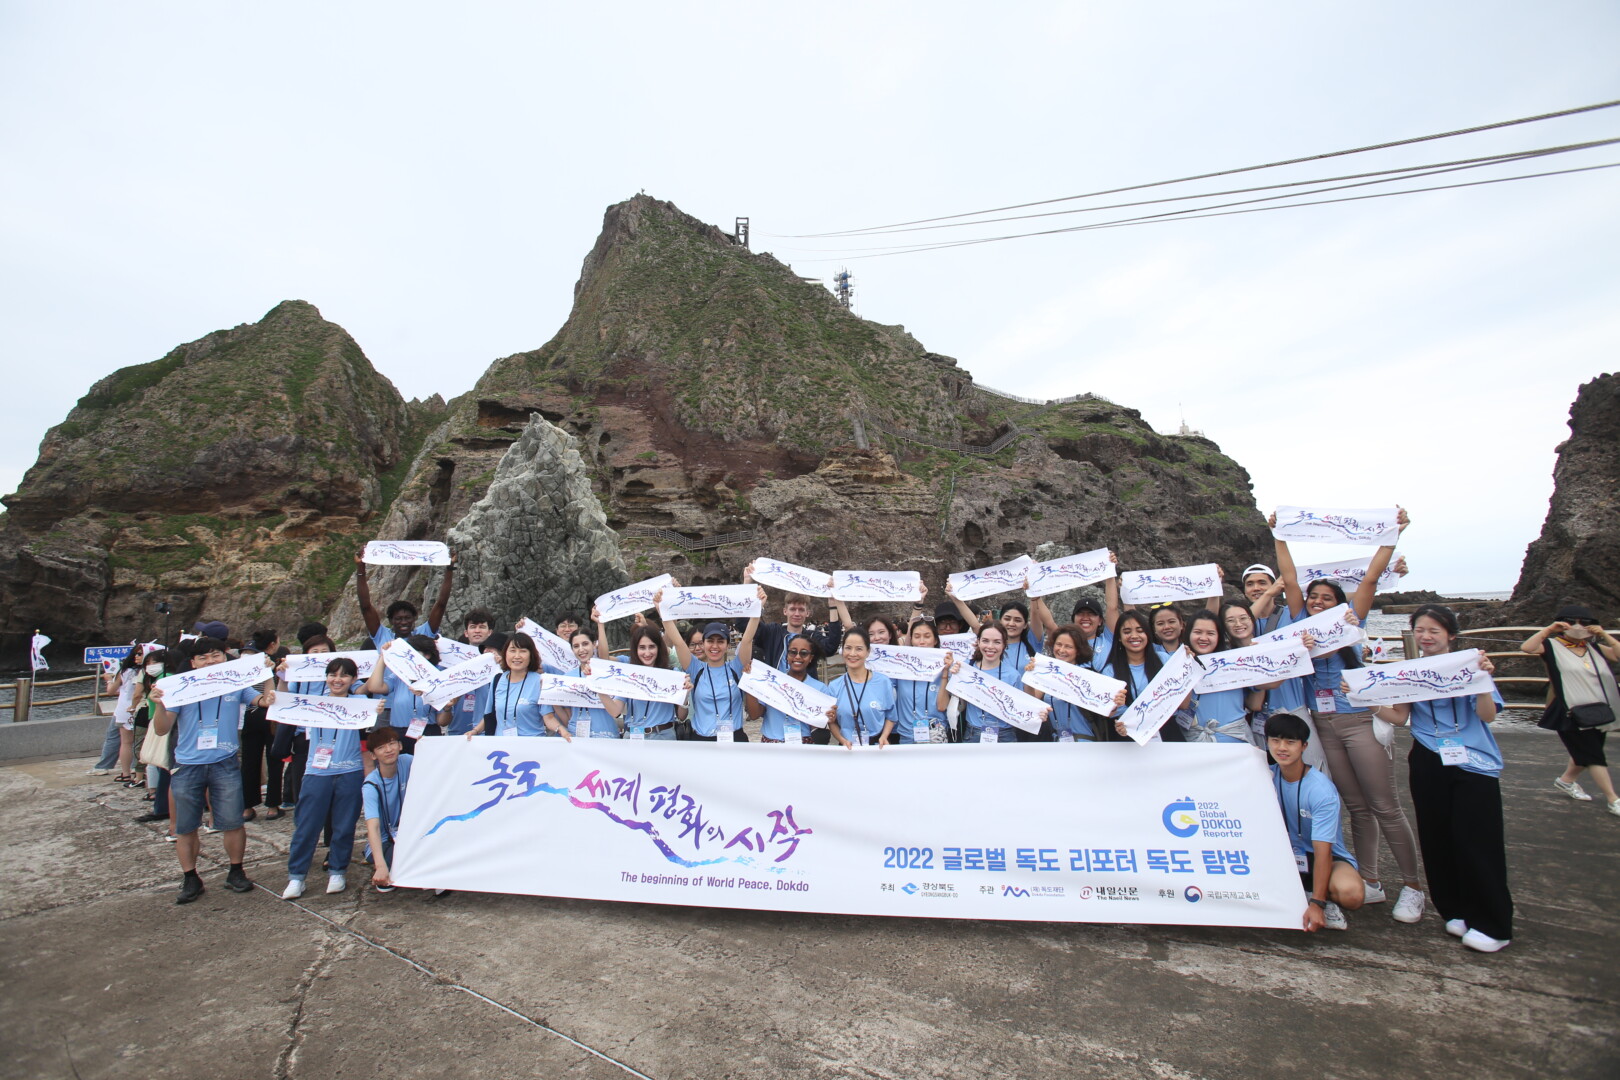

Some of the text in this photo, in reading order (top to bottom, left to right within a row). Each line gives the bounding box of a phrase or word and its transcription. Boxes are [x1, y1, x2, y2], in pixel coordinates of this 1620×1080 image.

[1324, 515, 1343, 523] 세계
[1380, 567, 1391, 578] 작
[88, 648, 131, 656] 독도이사부
[1236, 654, 1255, 664] 세계
[1398, 668, 1420, 679] 세계
[1450, 668, 1476, 682] 시작
[1198, 802, 1220, 810] 2022
[575, 769, 641, 816] 세계
[649, 784, 724, 850] 평화의
[723, 804, 813, 863] 시작
[1200, 810, 1227, 818] Global
[1201, 819, 1242, 830] DOKDO
[1203, 830, 1244, 838] Reporter
[884, 847, 1251, 876] 2022 글로벌 독도 리포터 독도 탐방
[620, 871, 638, 882] The
[641, 872, 689, 886] beginning
[692, 876, 704, 886] of
[707, 876, 735, 888] World
[776, 879, 809, 892] Dokdo
[880, 883, 895, 892] 주최
[922, 882, 955, 892] 경상북도
[980, 885, 994, 895] 주관
[1096, 886, 1138, 896] 내일신문
[1158, 889, 1175, 898] 후원
[1206, 890, 1260, 900] 국립국제교육원
